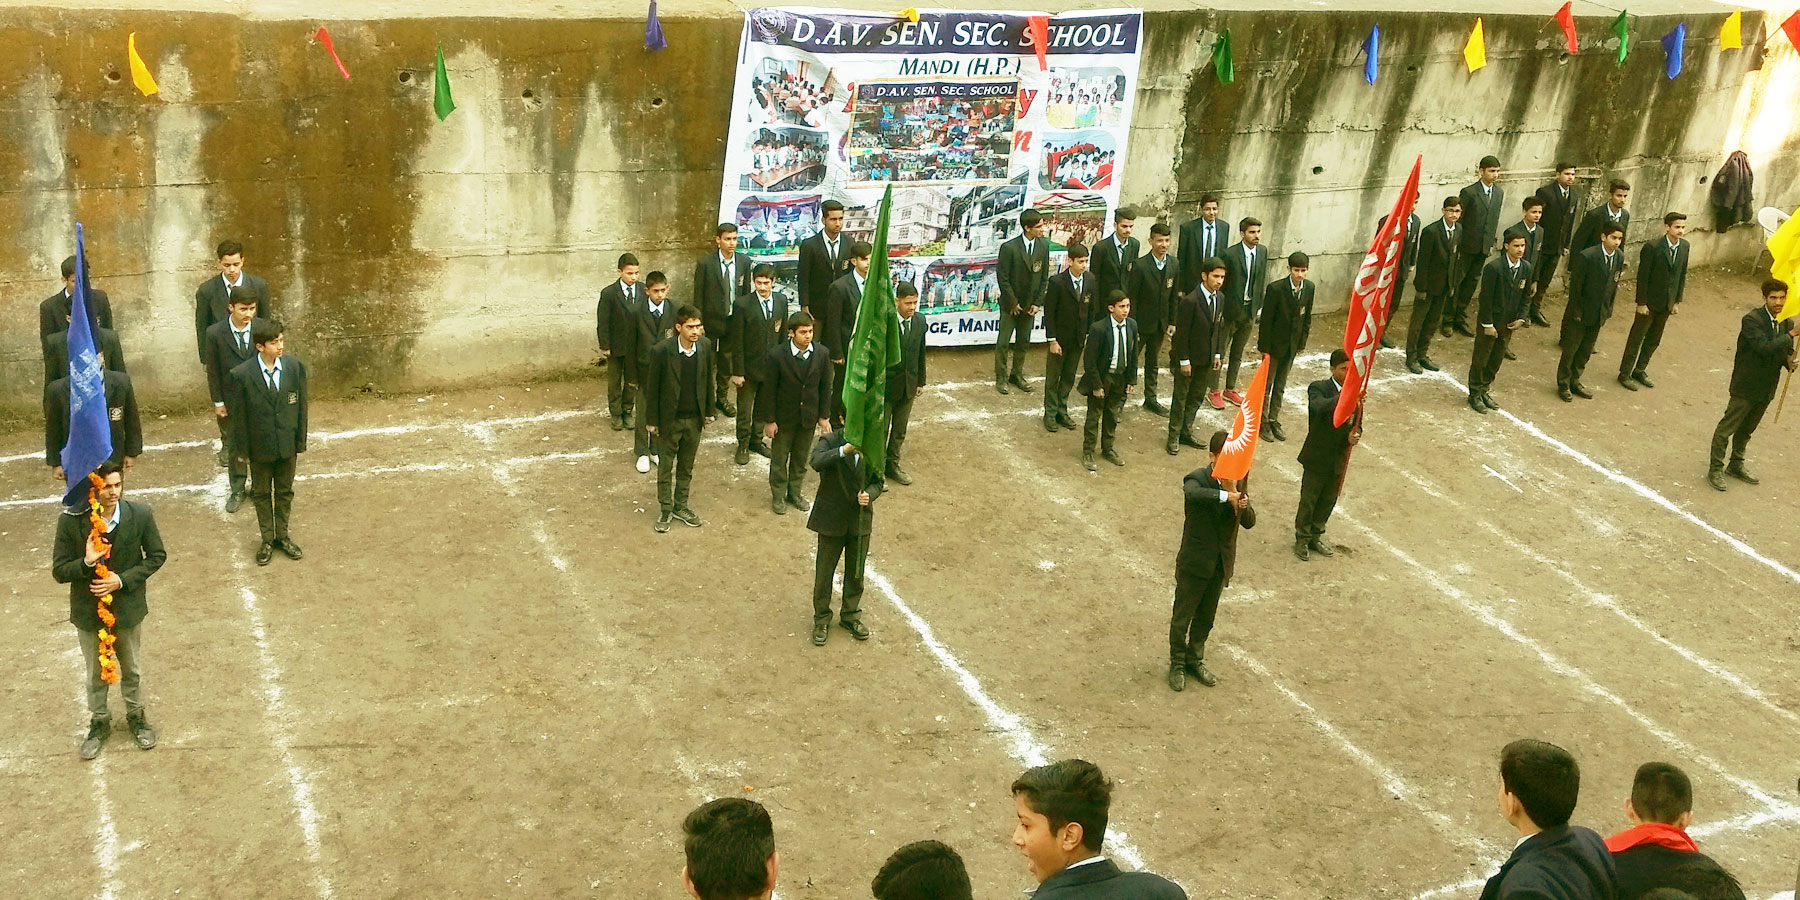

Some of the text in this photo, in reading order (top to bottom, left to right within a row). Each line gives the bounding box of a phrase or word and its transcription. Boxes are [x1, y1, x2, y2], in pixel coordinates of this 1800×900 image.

[791, 17, 873, 46] D.A.V.
[880, 21, 944, 46] SEN.
[952, 21, 1009, 47] SEC.
[967, 56, 1021, 77] (H.P.)
[876, 86, 910, 97] D.A.V.
[913, 85, 937, 96] SEN.
[940, 85, 967, 96] SEC.
[969, 85, 1014, 96] SCHOOL
